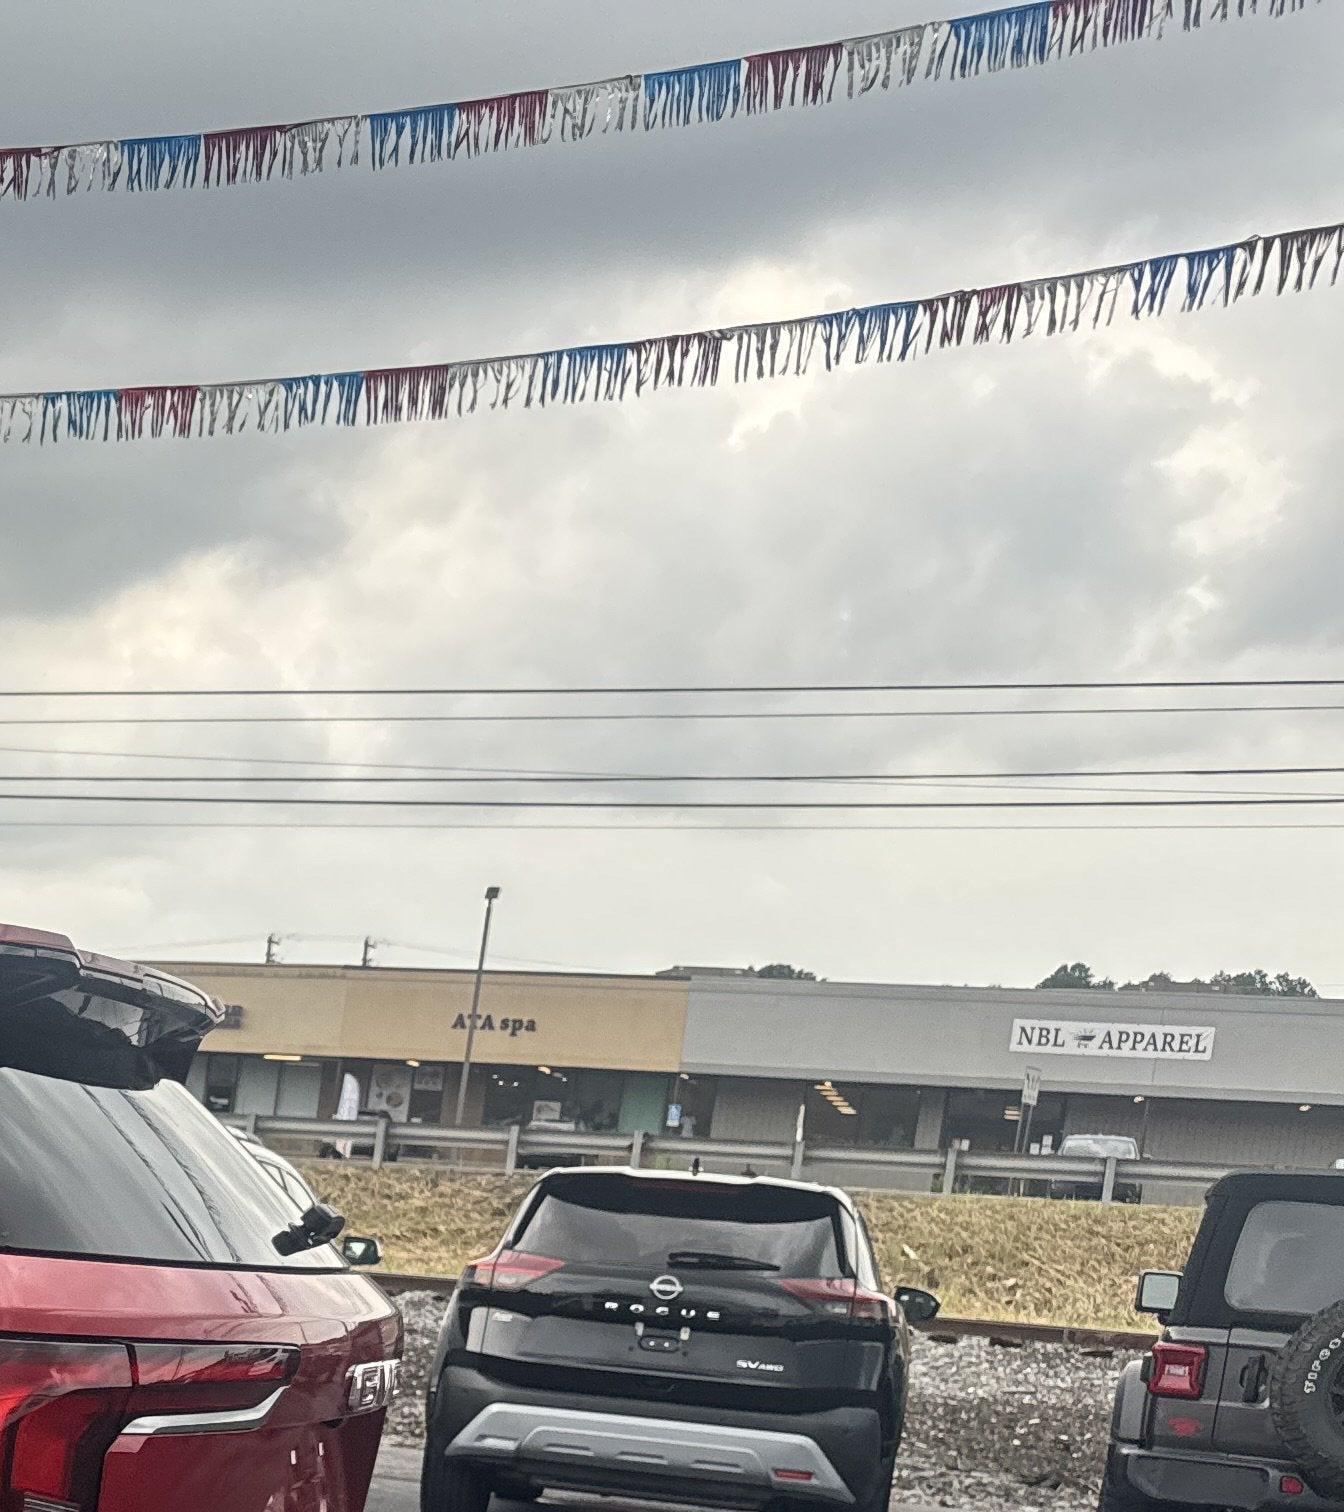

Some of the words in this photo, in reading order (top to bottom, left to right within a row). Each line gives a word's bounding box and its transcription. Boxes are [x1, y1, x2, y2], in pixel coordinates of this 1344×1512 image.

[500, 1018, 536, 1037] spa
[1016, 1026, 1066, 1048] NBL
[1098, 1030, 1208, 1054] APPAREL
[604, 1301, 721, 1320] ROGUE
